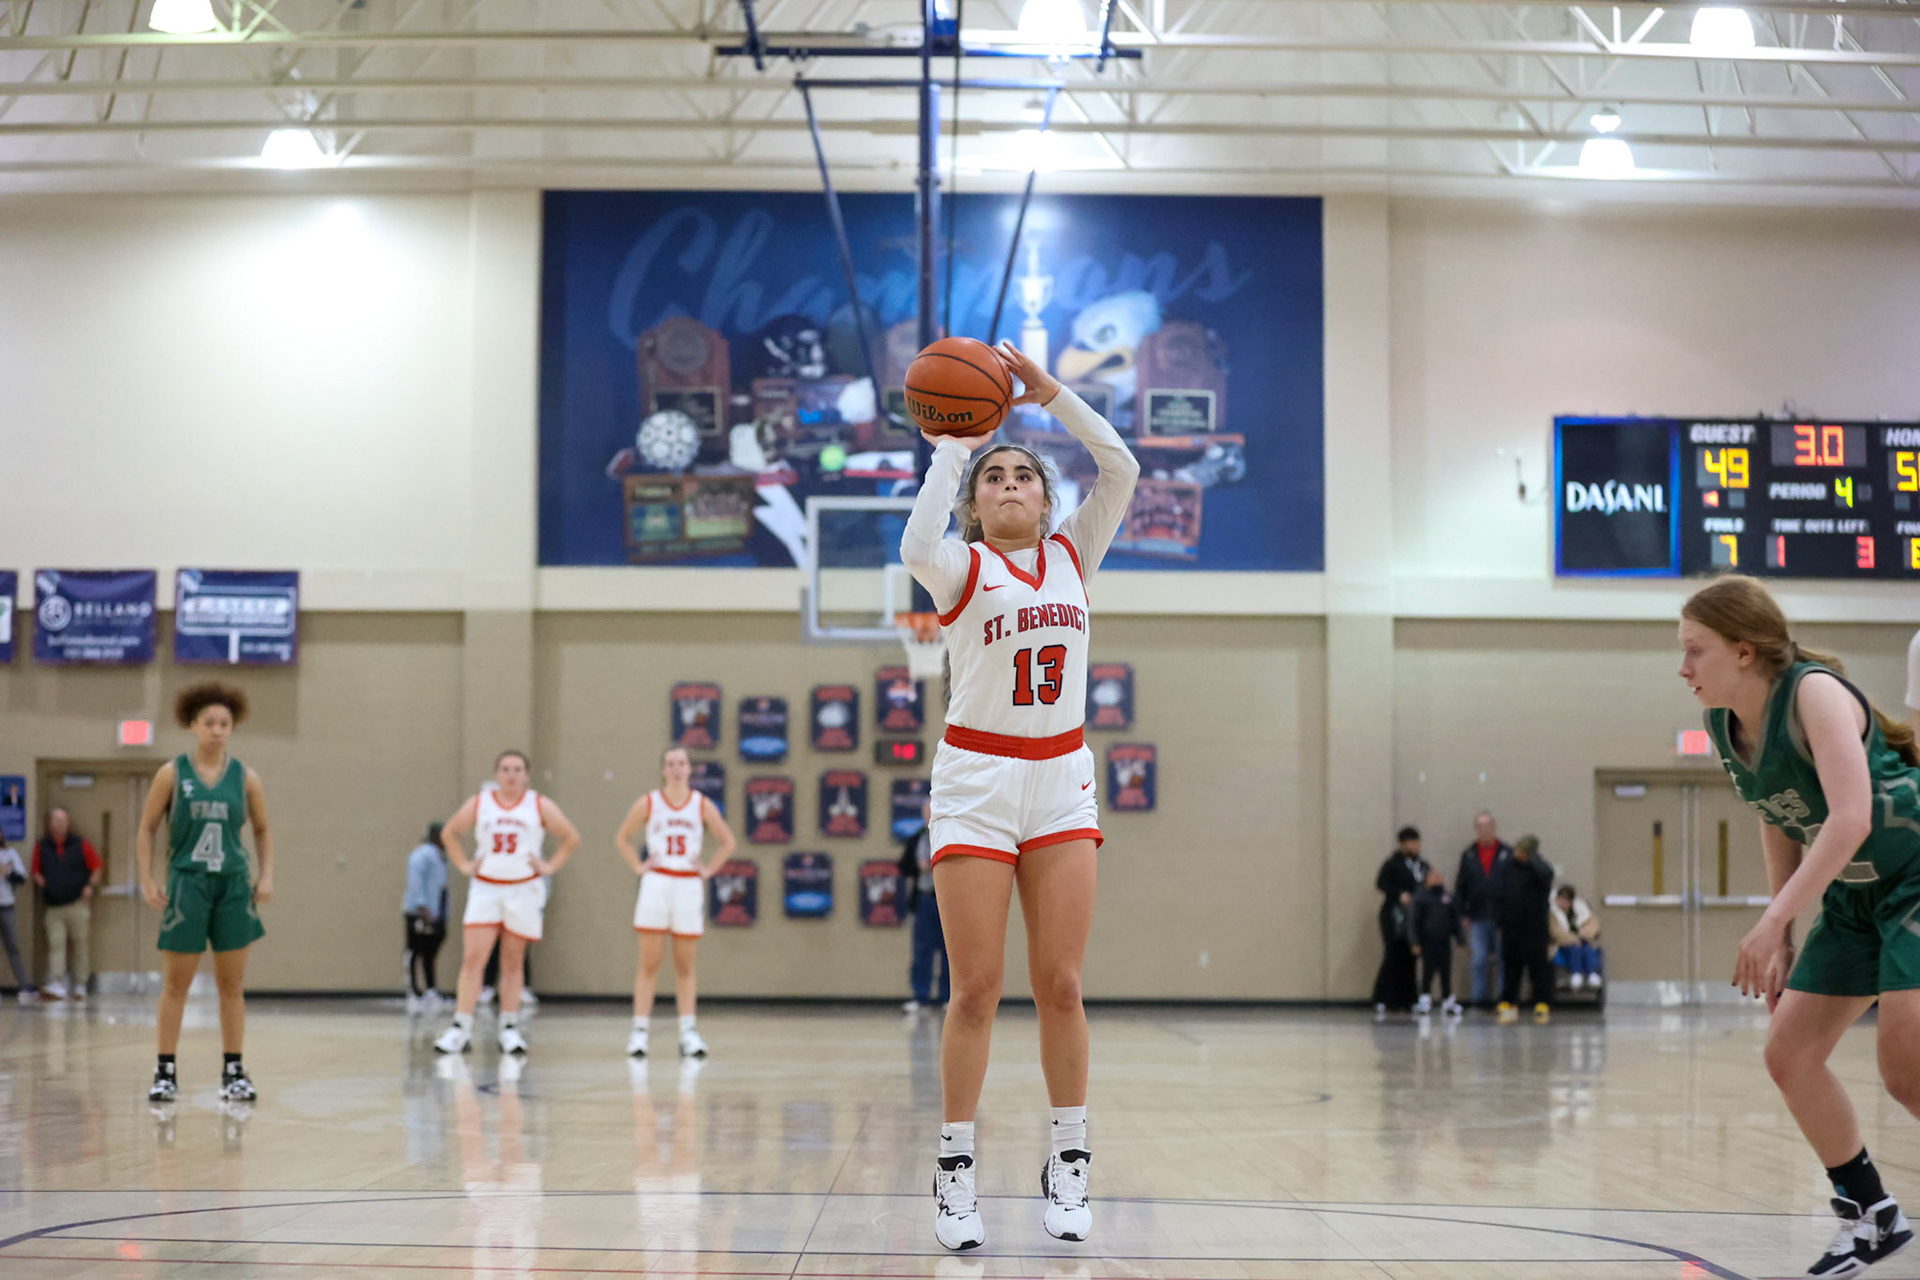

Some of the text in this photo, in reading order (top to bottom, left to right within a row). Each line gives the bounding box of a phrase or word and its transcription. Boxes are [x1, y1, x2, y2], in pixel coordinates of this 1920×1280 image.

[606, 206, 1253, 343] Champons
[907, 395, 974, 423] Wilson
[1690, 423, 1756, 444] GUEST
[1793, 425, 1844, 466] 3.0
[1704, 448, 1749, 488] 49
[1566, 479, 1664, 515] DASANI
[1769, 476, 1853, 508] PERIOD 4
[1704, 517, 1745, 533] FOULS
[1774, 519, 1866, 533] TIME OUTS LEFT
[1719, 534, 1737, 566] 7
[1777, 535, 1785, 567] 1
[1856, 536, 1875, 568] 3
[984, 603, 1086, 646] ST. BENEDICT
[1012, 643, 1068, 706] 13
[191, 821, 225, 872] 4
[492, 833, 518, 854] 55
[667, 834, 686, 855] 15
